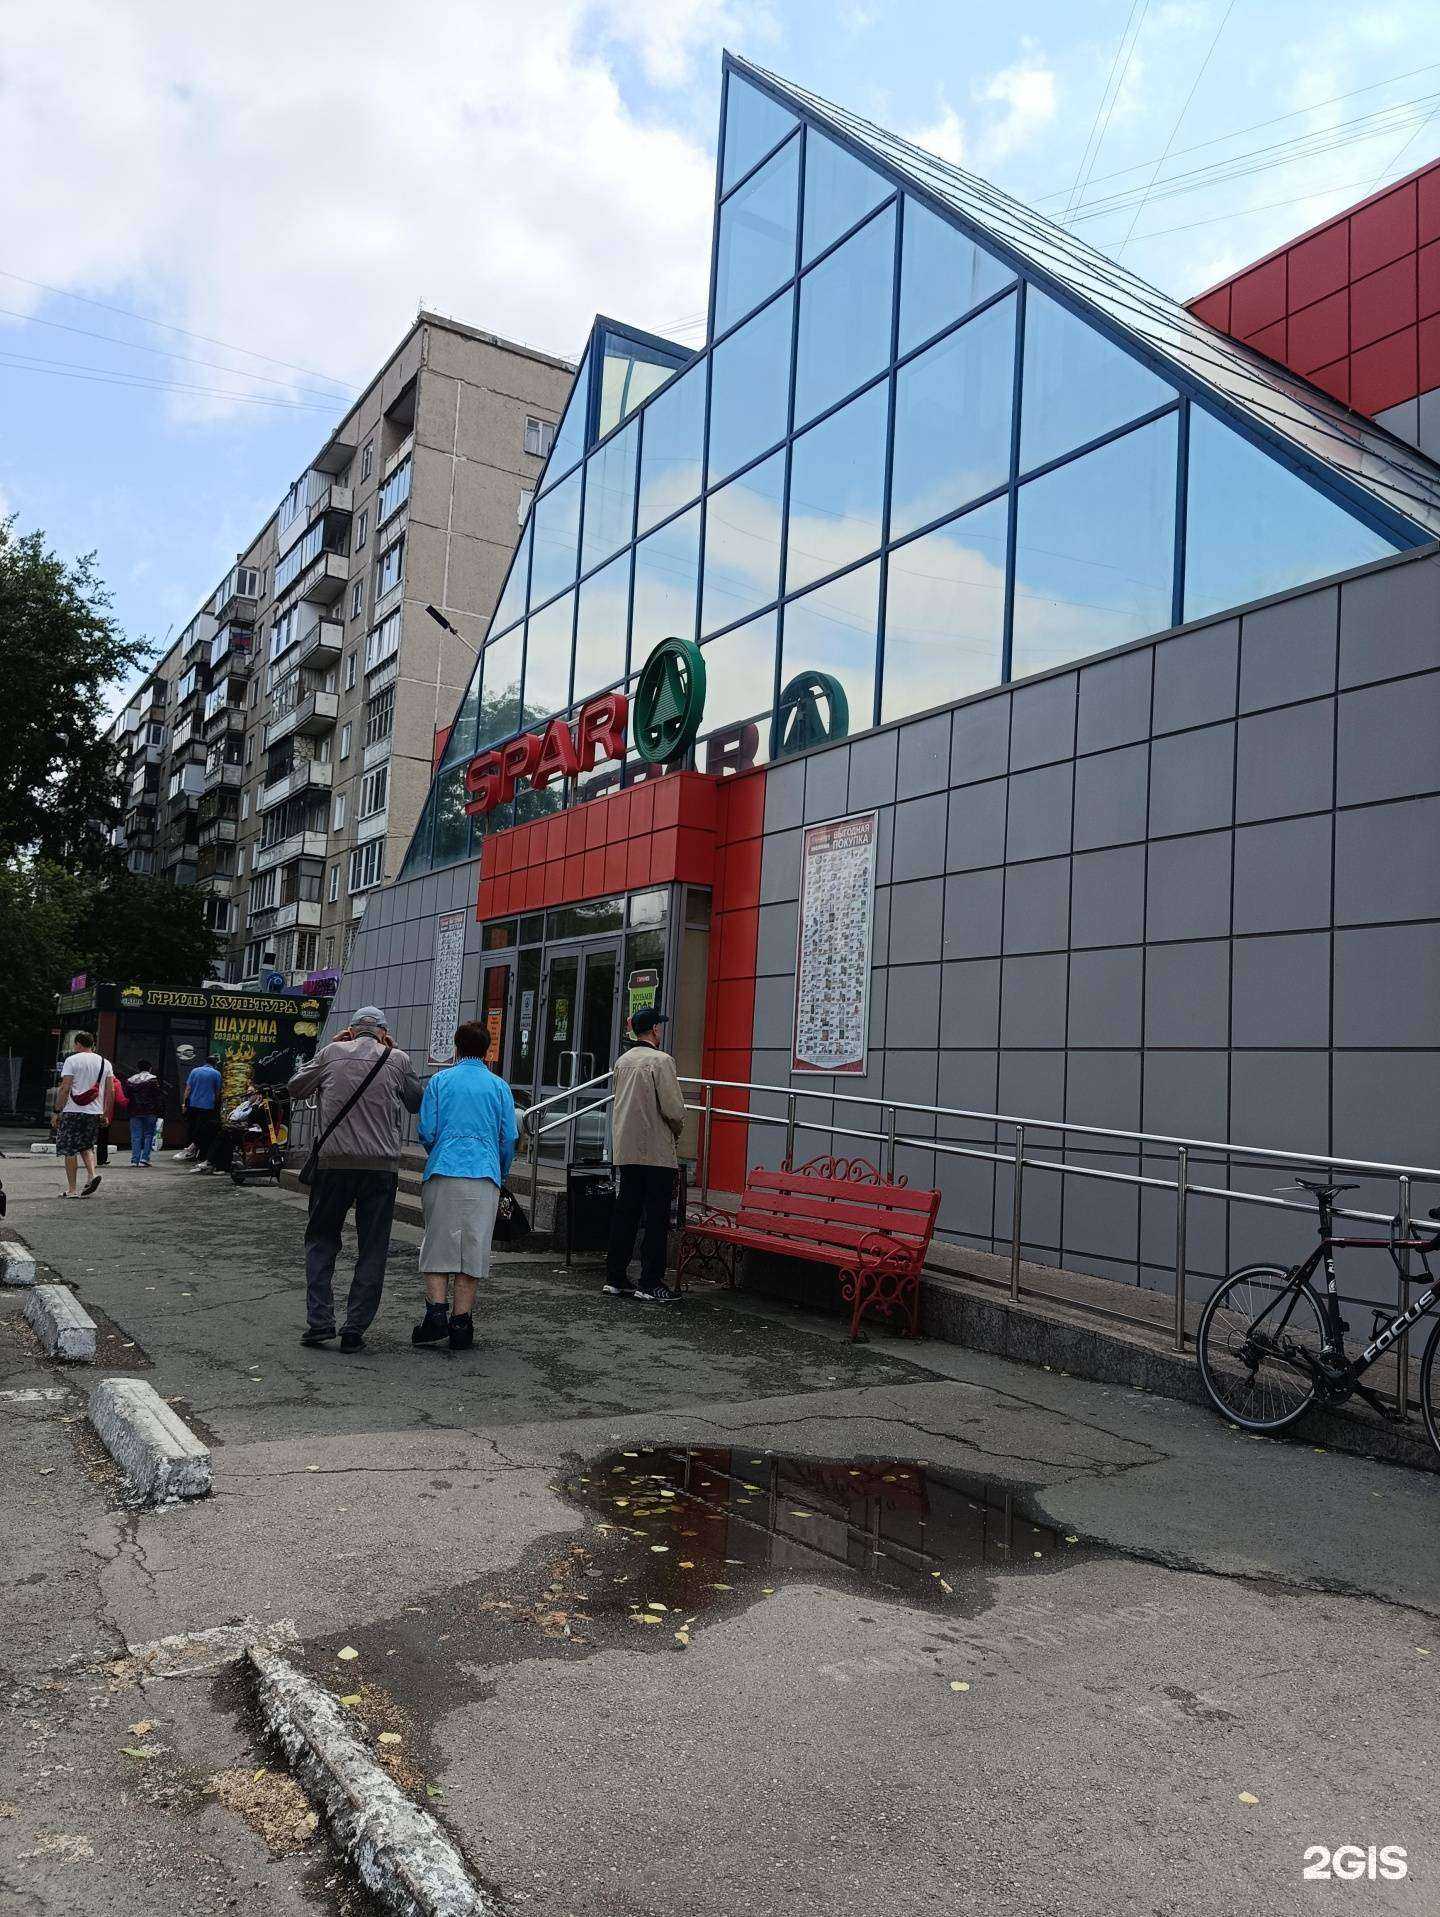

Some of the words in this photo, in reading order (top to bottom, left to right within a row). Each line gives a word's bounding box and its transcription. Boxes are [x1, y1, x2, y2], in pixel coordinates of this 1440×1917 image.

[465, 692, 629, 816] SPAR
[833, 823, 870, 839] ВЫГОДНАЯ
[833, 834, 869, 850] ПОКУПКА
[148, 990, 208, 1008] ГРИЛЬ
[210, 994, 299, 1014] КУЛЬТУРА
[215, 1016, 278, 1035] ШАУРМА
[214, 1032, 240, 1041] СОЗДАЙ
[241, 1033, 258, 1042] СВОЙ
[260, 1034, 277, 1043] ВКУС
[1363, 1290, 1436, 1363] FOCUS
